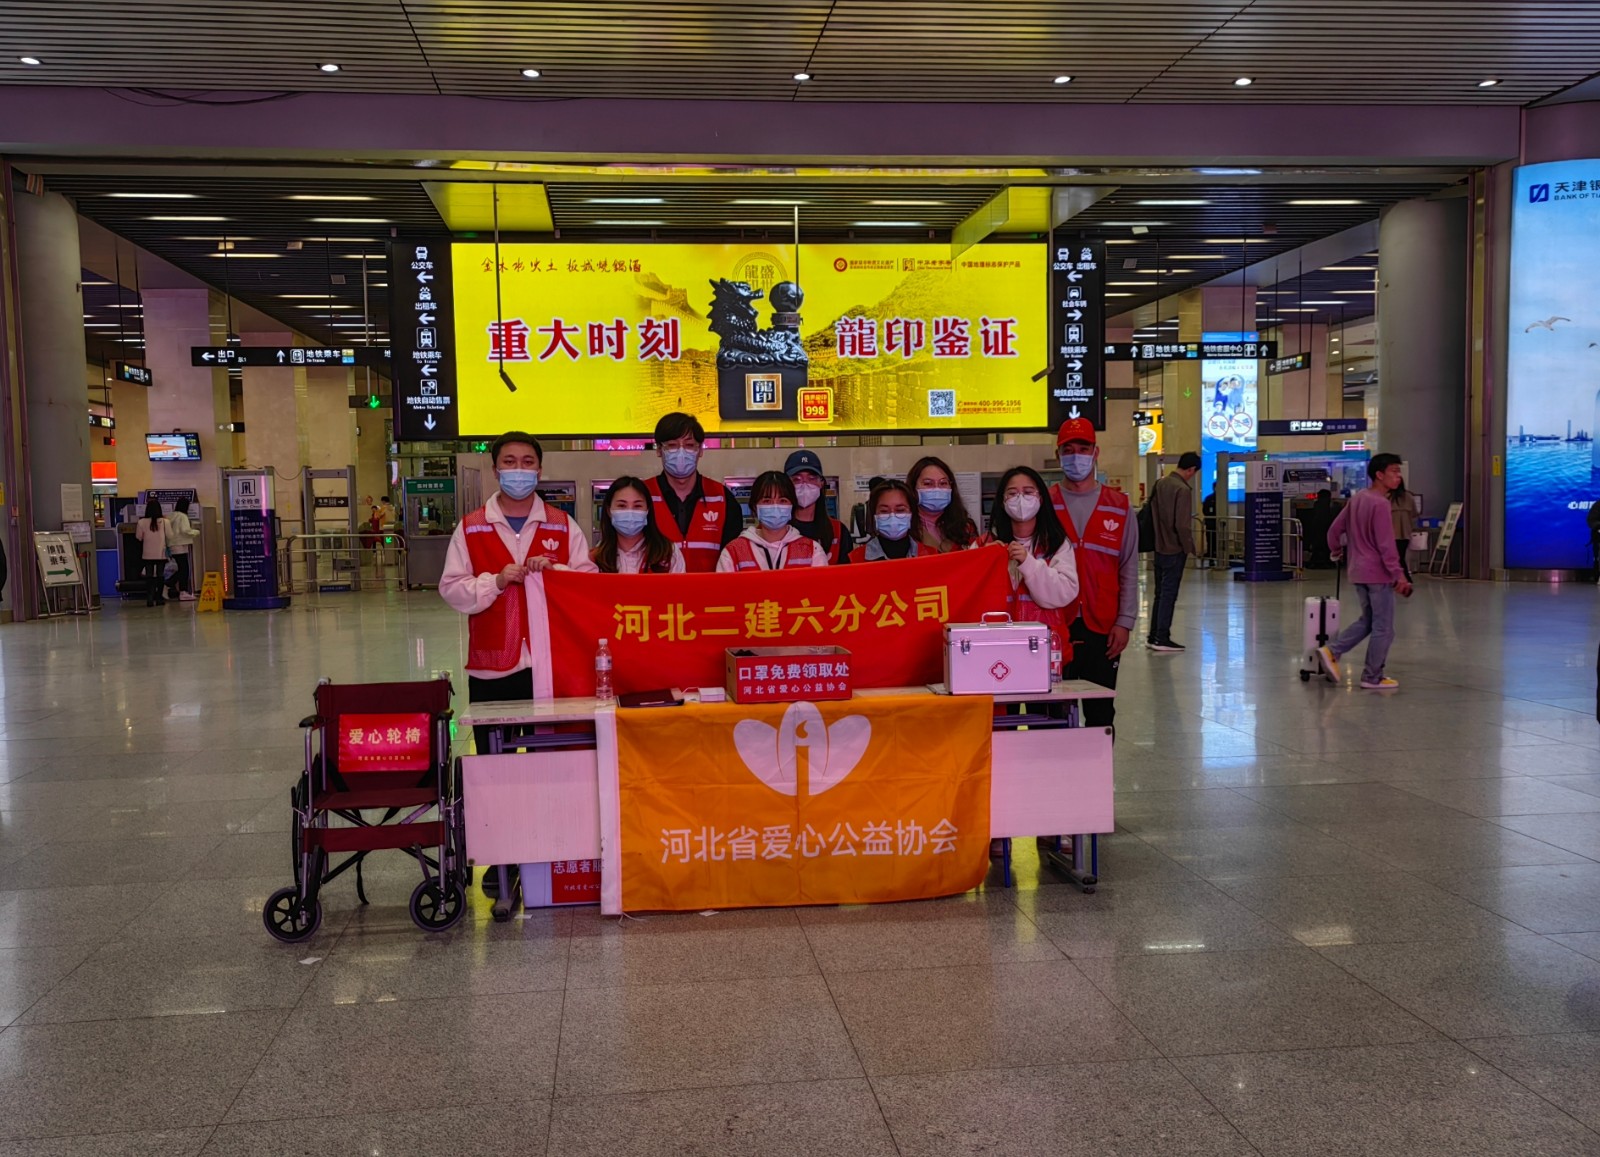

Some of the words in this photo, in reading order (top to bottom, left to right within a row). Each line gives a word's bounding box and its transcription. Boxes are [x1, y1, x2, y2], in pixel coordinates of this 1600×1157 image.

[411, 261, 433, 270] 公交车
[1053, 262, 1073, 270] 公交车
[1076, 262, 1097, 270] 出租车
[415, 302, 437, 310] 出租车
[487, 318, 682, 362] 重大时刻
[836, 317, 1019, 358] 龍印鉴证
[306, 349, 340, 358] 地铁乘车
[1060, 346, 1088, 354] 地铁乘车
[1155, 345, 1186, 353] 地铁乘车
[218, 350, 235, 358] 出口
[412, 351, 442, 359] 地铁乘车
[406, 396, 450, 404] 地铁自动售票
[612, 585, 950, 642] 河北二建六分公司
[739, 662, 849, 680] 口罩免费领取处
[743, 682, 847, 695] 河北省爱心公益协会
[349, 727, 421, 745] 爱心轮椅
[660, 818, 958, 864] 河北省爱心公益协会
